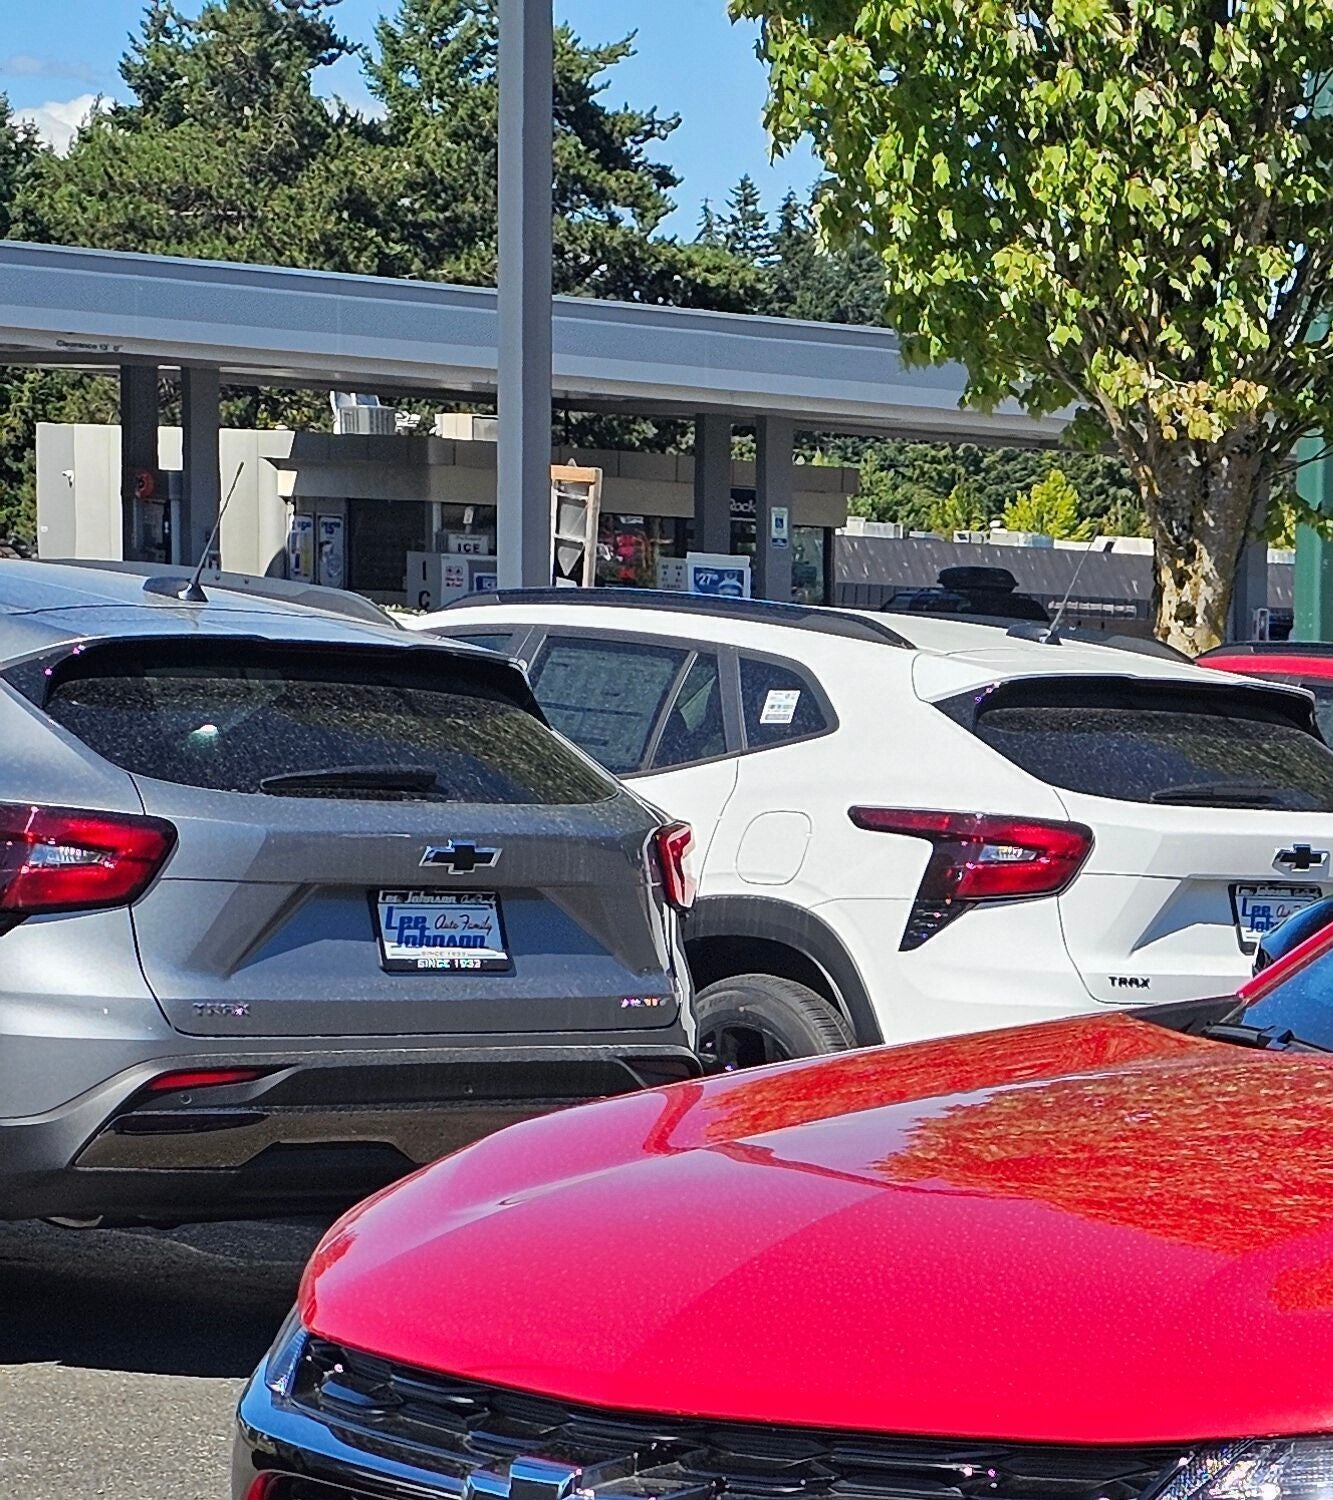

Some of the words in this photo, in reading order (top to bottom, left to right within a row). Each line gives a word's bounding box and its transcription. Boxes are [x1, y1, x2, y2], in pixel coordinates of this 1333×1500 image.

[457, 543, 480, 554] ICE
[1242, 897, 1273, 918] Lee
[385, 906, 430, 930] Lee
[434, 914, 459, 930] Auto
[459, 914, 492, 936] Family
[396, 925, 489, 949] Johnson
[417, 960, 451, 969] SINCE
[1108, 976, 1151, 990] TRAX
